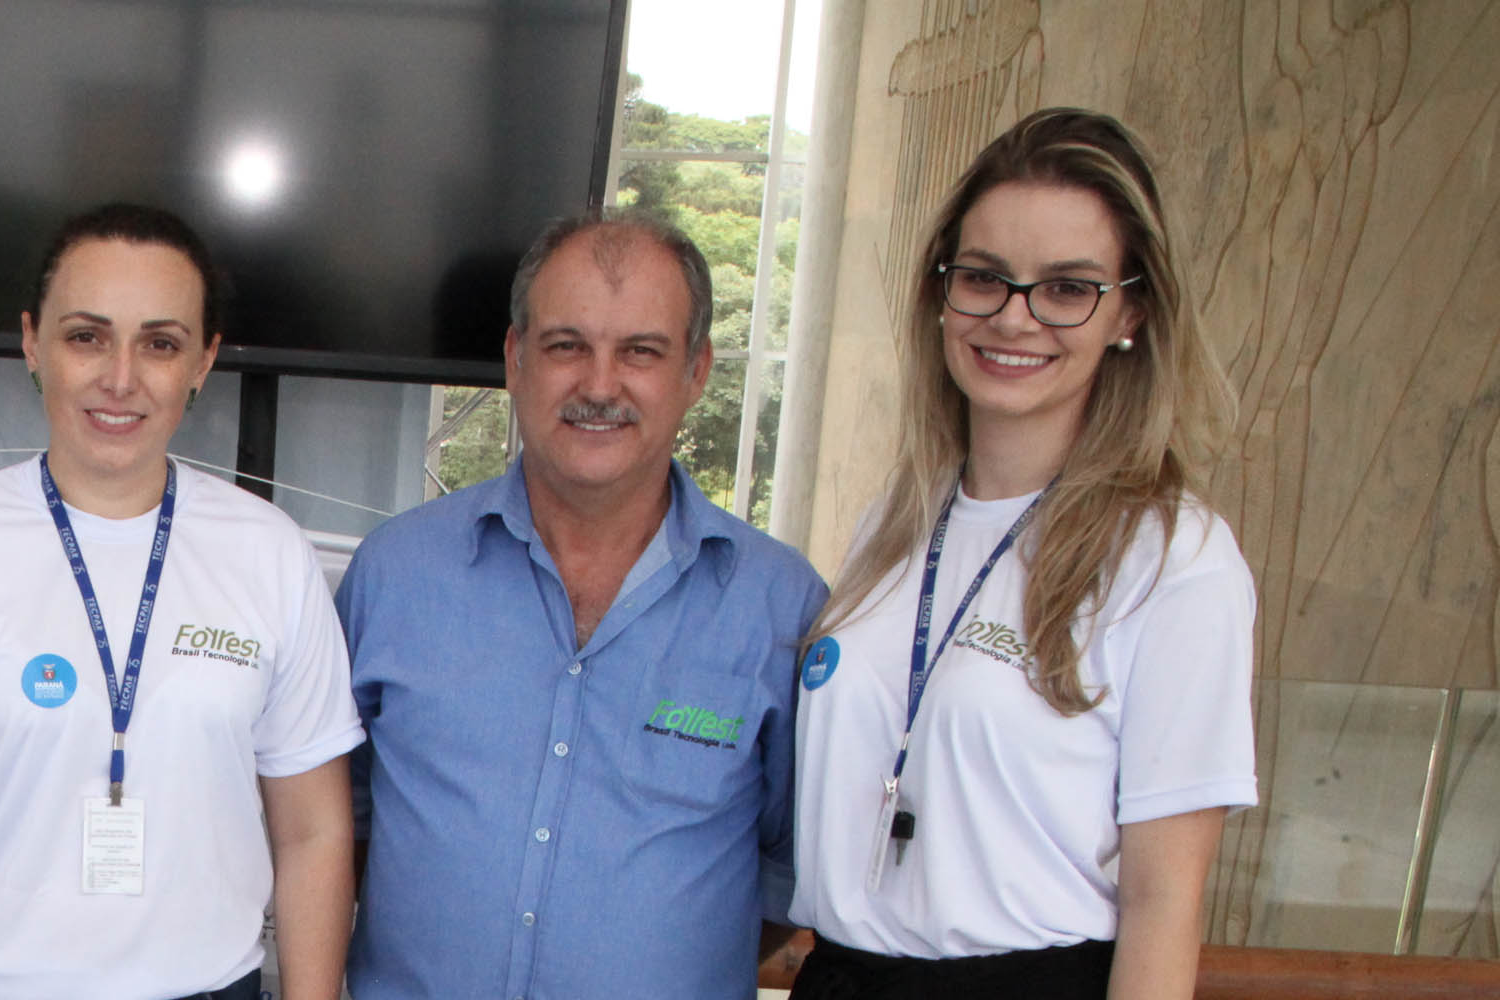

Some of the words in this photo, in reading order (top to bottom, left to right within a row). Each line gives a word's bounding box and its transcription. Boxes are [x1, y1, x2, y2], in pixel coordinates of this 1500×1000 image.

[62, 527, 79, 559] TECPAR
[152, 529, 165, 561] TECPAR
[89, 598, 104, 631] TECPAR
[136, 600, 150, 633] TECPAR
[172, 647, 199, 656] Brasil
[203, 650, 249, 666] Tecnologia
[121, 675, 134, 711] TECPAR
